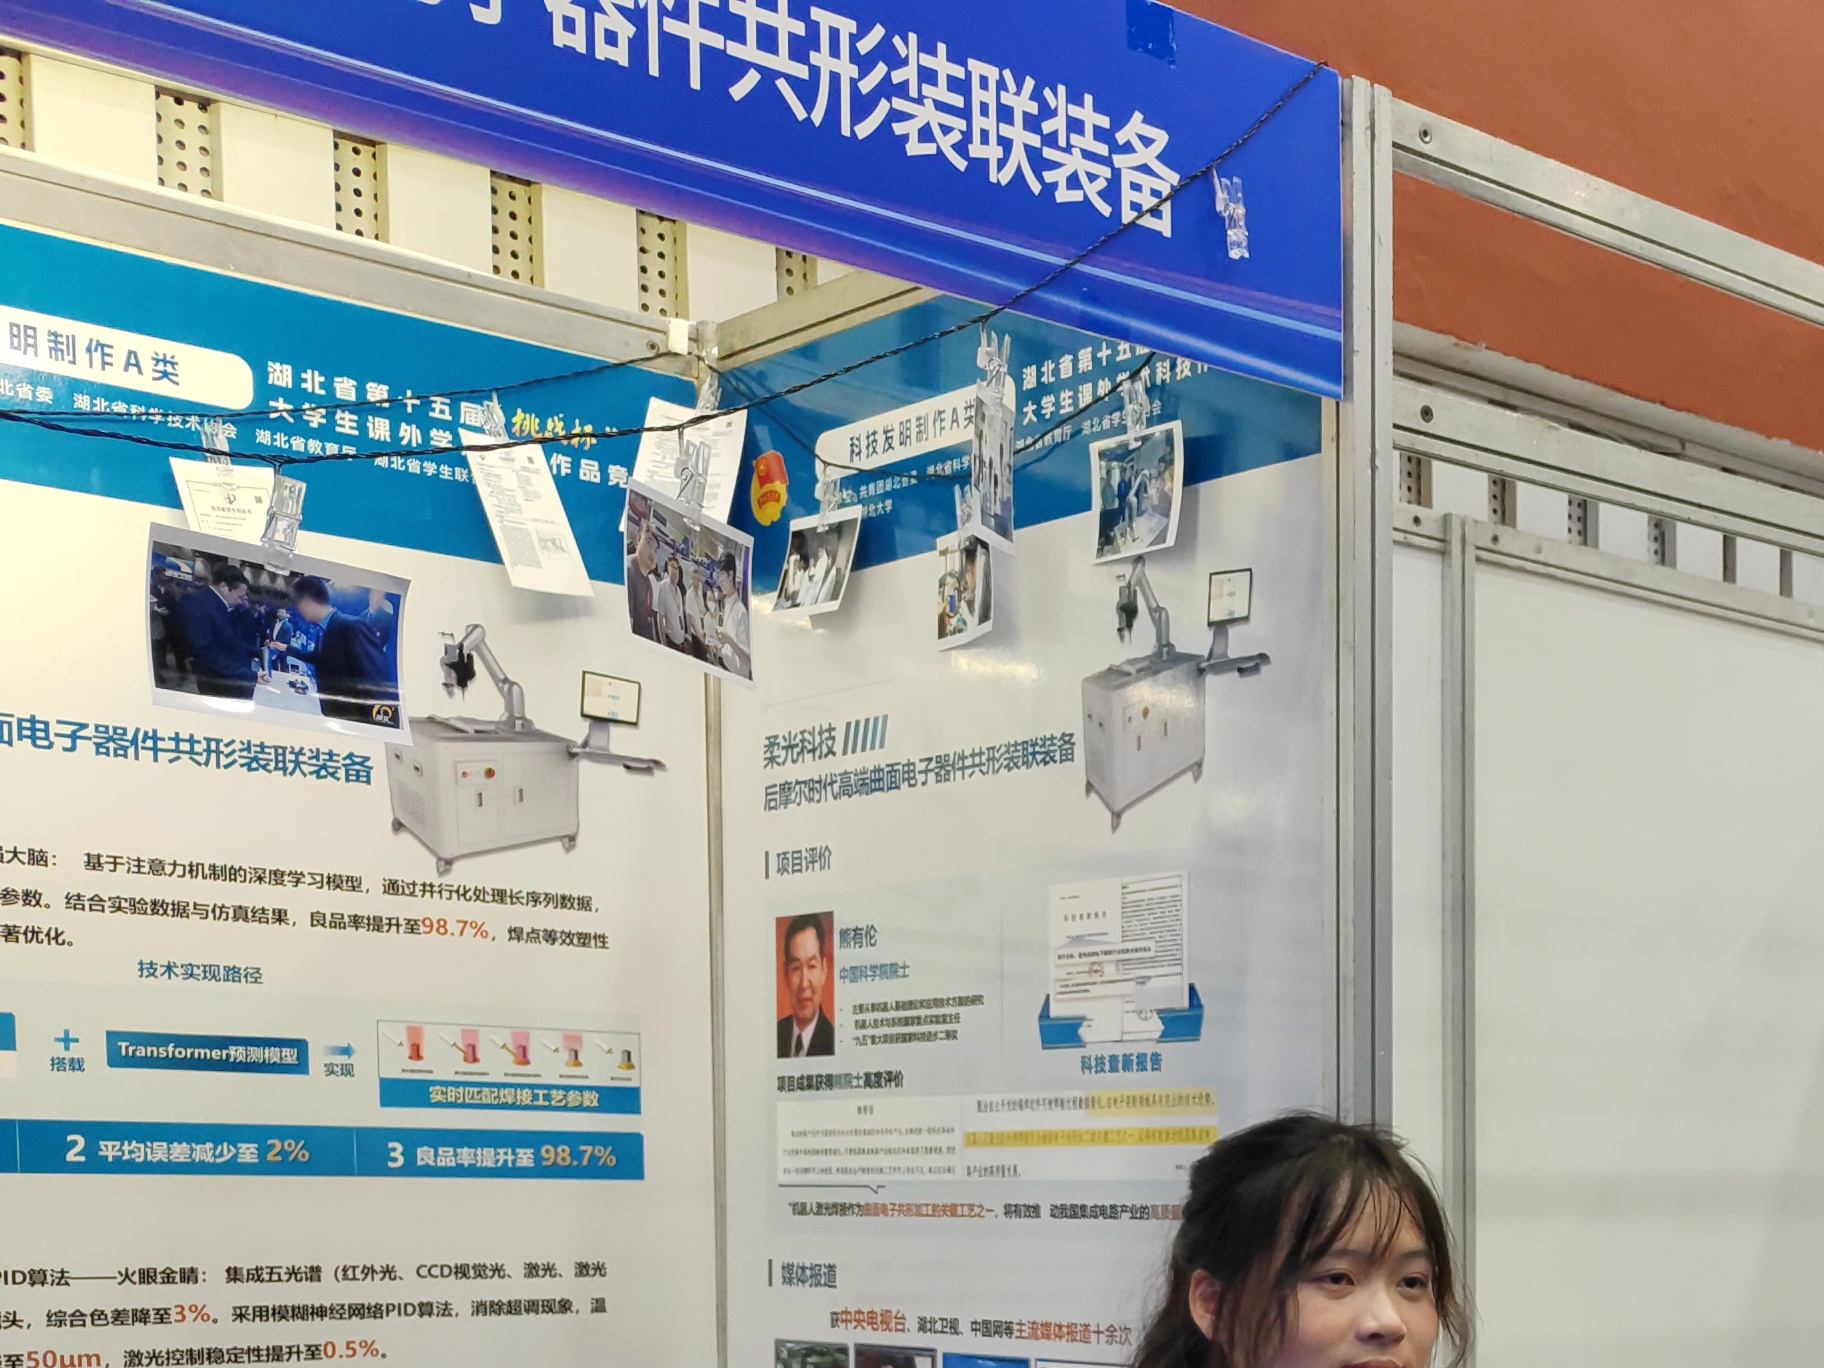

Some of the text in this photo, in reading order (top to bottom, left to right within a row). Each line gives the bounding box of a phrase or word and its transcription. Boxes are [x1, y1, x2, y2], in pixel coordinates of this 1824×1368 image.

[468, 0, 1181, 237] 器件共形装联装备
[8, 321, 181, 386] 明制作A类
[763, 722, 837, 769] 柔光科技
[763, 732, 1076, 812] 后摩尔时代高端曲面电子器件共形装联装备
[0, 846, 58, 868] 大脑：
[776, 845, 832, 877] 项目评价
[137, 958, 264, 985] 技术实现路径
[50, 1056, 85, 1073] 搭载
[117, 1041, 299, 1066] Transformer预测模型
[1080, 1051, 1163, 1075] 科技查新报告
[323, 1062, 356, 1078] 实现
[65, 1133, 311, 1164] 2 平均误差减少至 2%
[386, 1141, 618, 1169] 3 良品率提升至 98.7%
[781, 1261, 838, 1289] 媒体报道
[0, 1297, 608, 1331] 头，综合色差降至3%。采用模糊神经网络PID算法，消除超调现象，温
